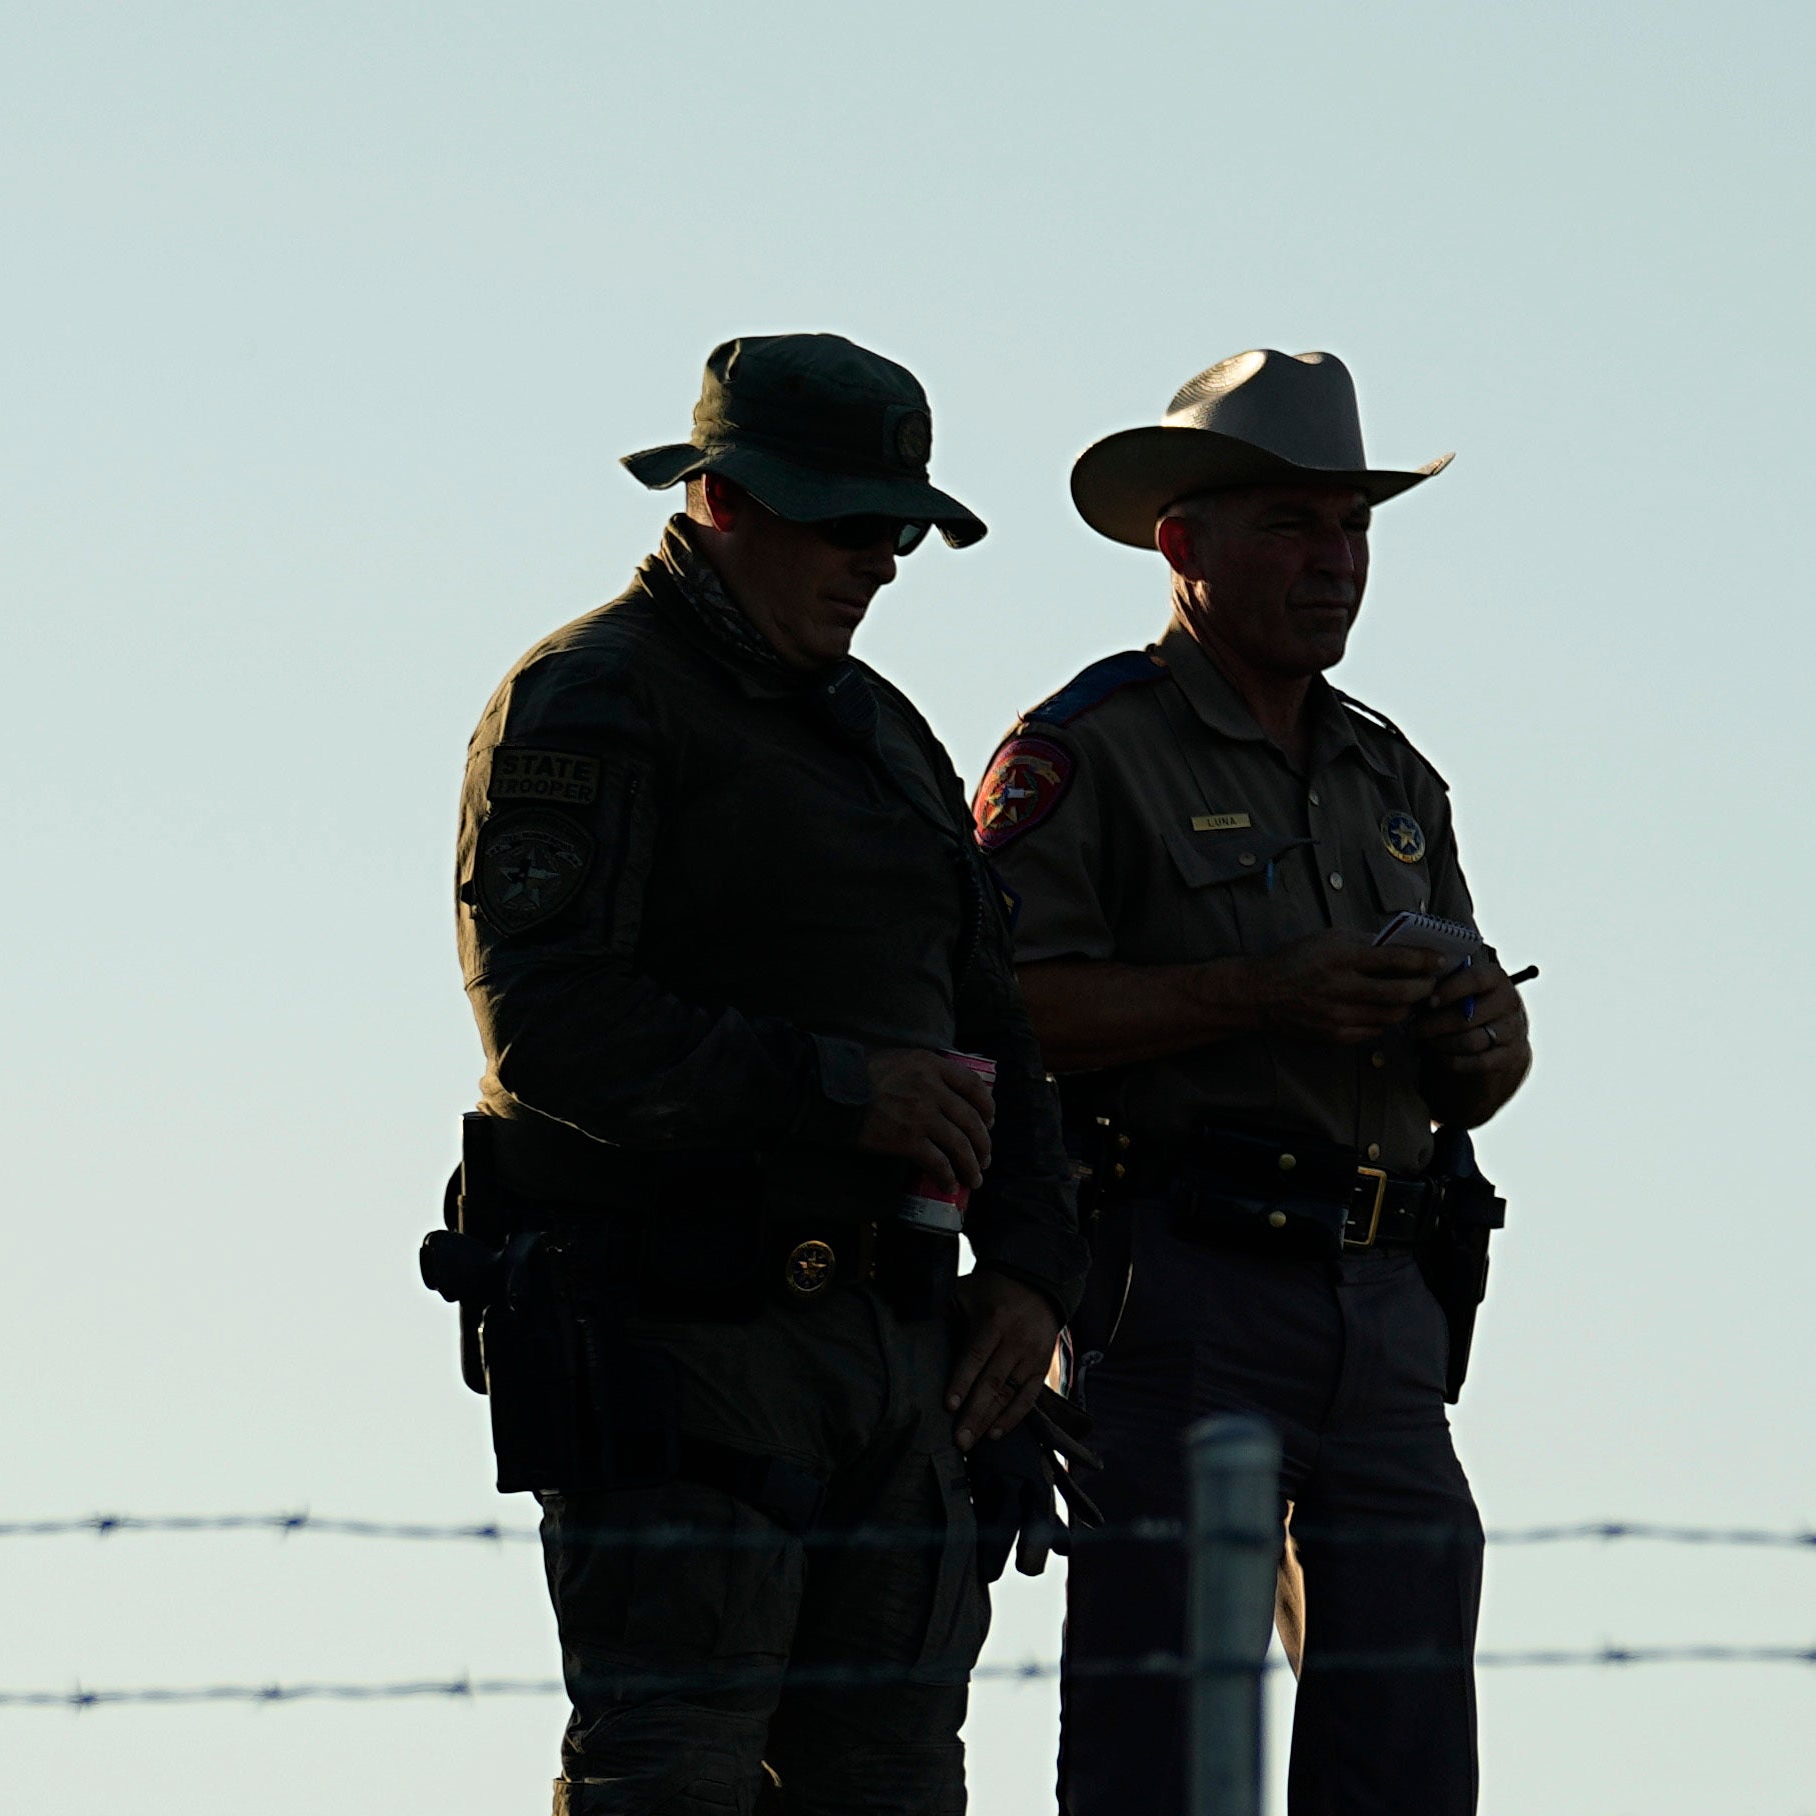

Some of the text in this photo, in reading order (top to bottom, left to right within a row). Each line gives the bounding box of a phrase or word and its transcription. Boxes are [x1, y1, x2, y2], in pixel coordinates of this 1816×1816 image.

[502, 755, 592, 779] STATE
[497, 778, 593, 801] TROOPER
[1207, 817, 1237, 827] LUNA
